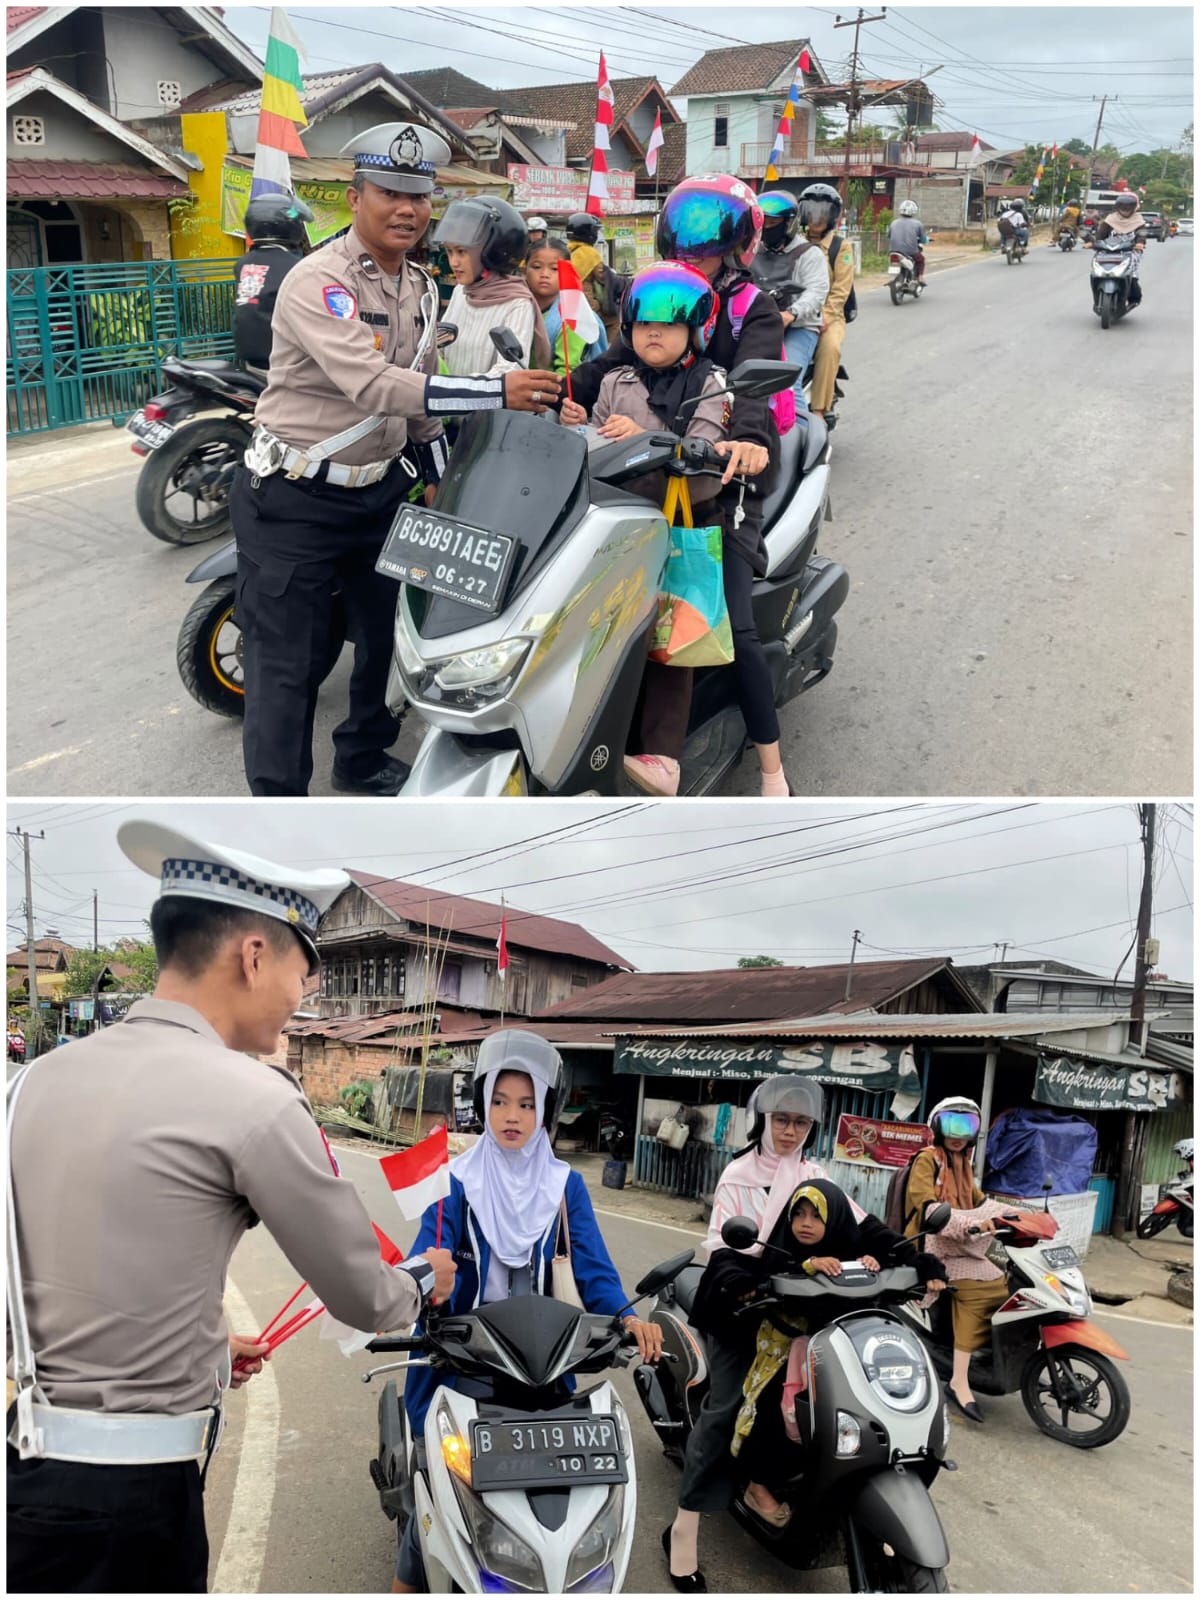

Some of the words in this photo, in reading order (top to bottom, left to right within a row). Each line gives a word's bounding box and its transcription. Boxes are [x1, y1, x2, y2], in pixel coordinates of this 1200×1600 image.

[298, 184, 341, 201] Kia
[620, 1039, 772, 1069] Angkringan
[671, 1067, 711, 1078] Menjual
[1039, 1059, 1125, 1098] Angkringan
[479, 1430, 492, 1453] B
[511, 1427, 565, 1450] 3119
[572, 1425, 611, 1447] NXP
[593, 1456, 617, 1470] 22
